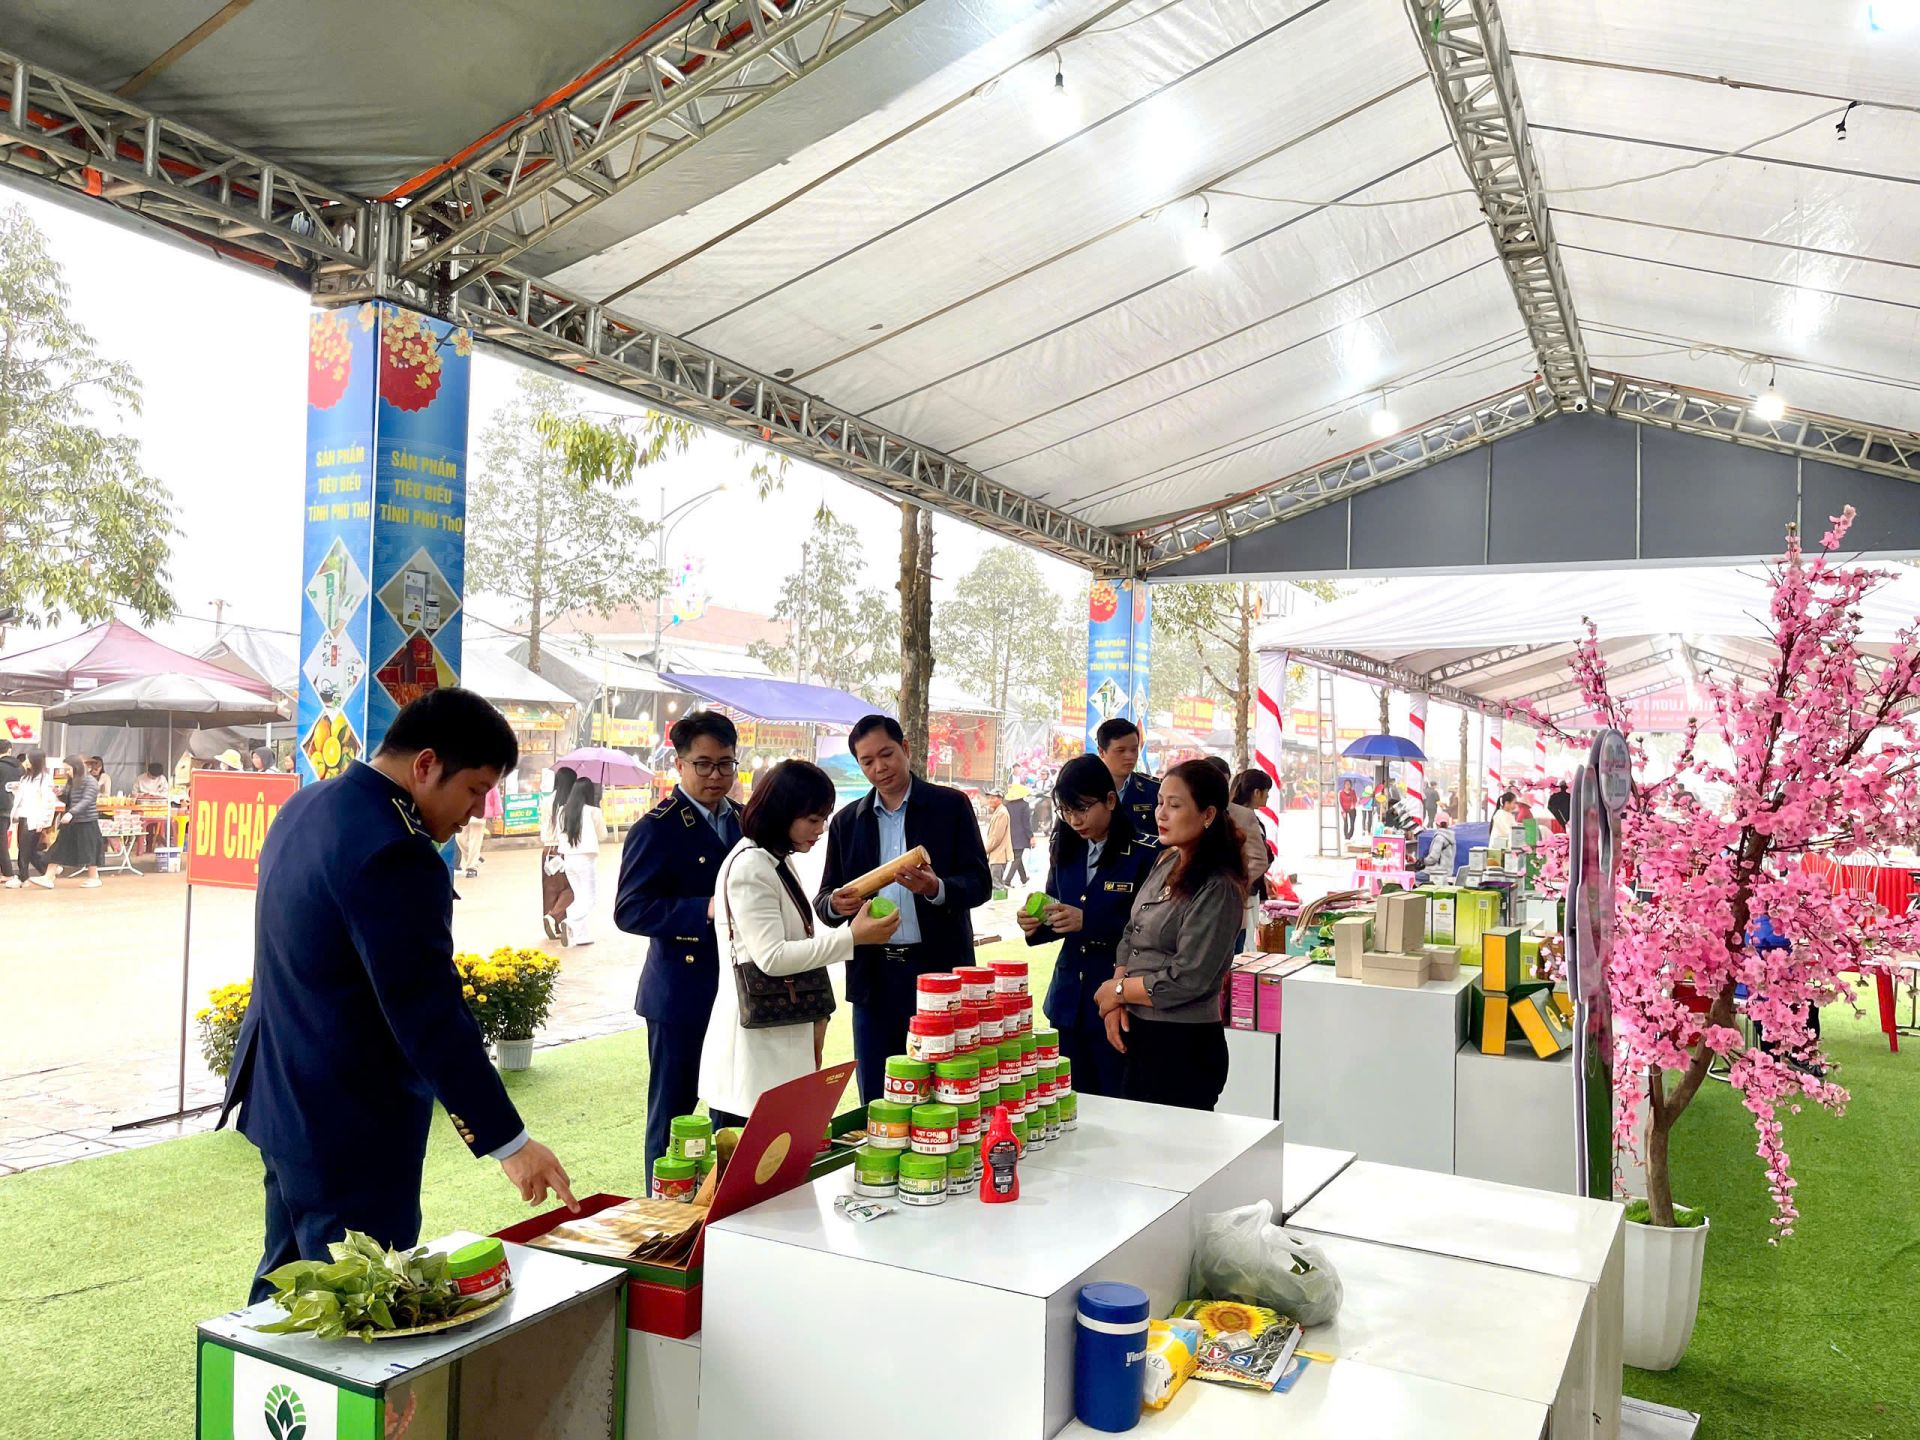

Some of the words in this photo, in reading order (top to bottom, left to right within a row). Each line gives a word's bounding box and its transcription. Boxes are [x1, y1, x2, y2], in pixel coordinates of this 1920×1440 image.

[391, 448, 417, 469] SẢN
[421, 455, 457, 479] PHẨM
[394, 479, 421, 499] TIÊU
[424, 482, 452, 505] BIỂU
[308, 500, 329, 523] TỈNH
[380, 499, 409, 524] TỈNH
[413, 508, 438, 529] PHÚ
[196, 800, 219, 857] ĐI
